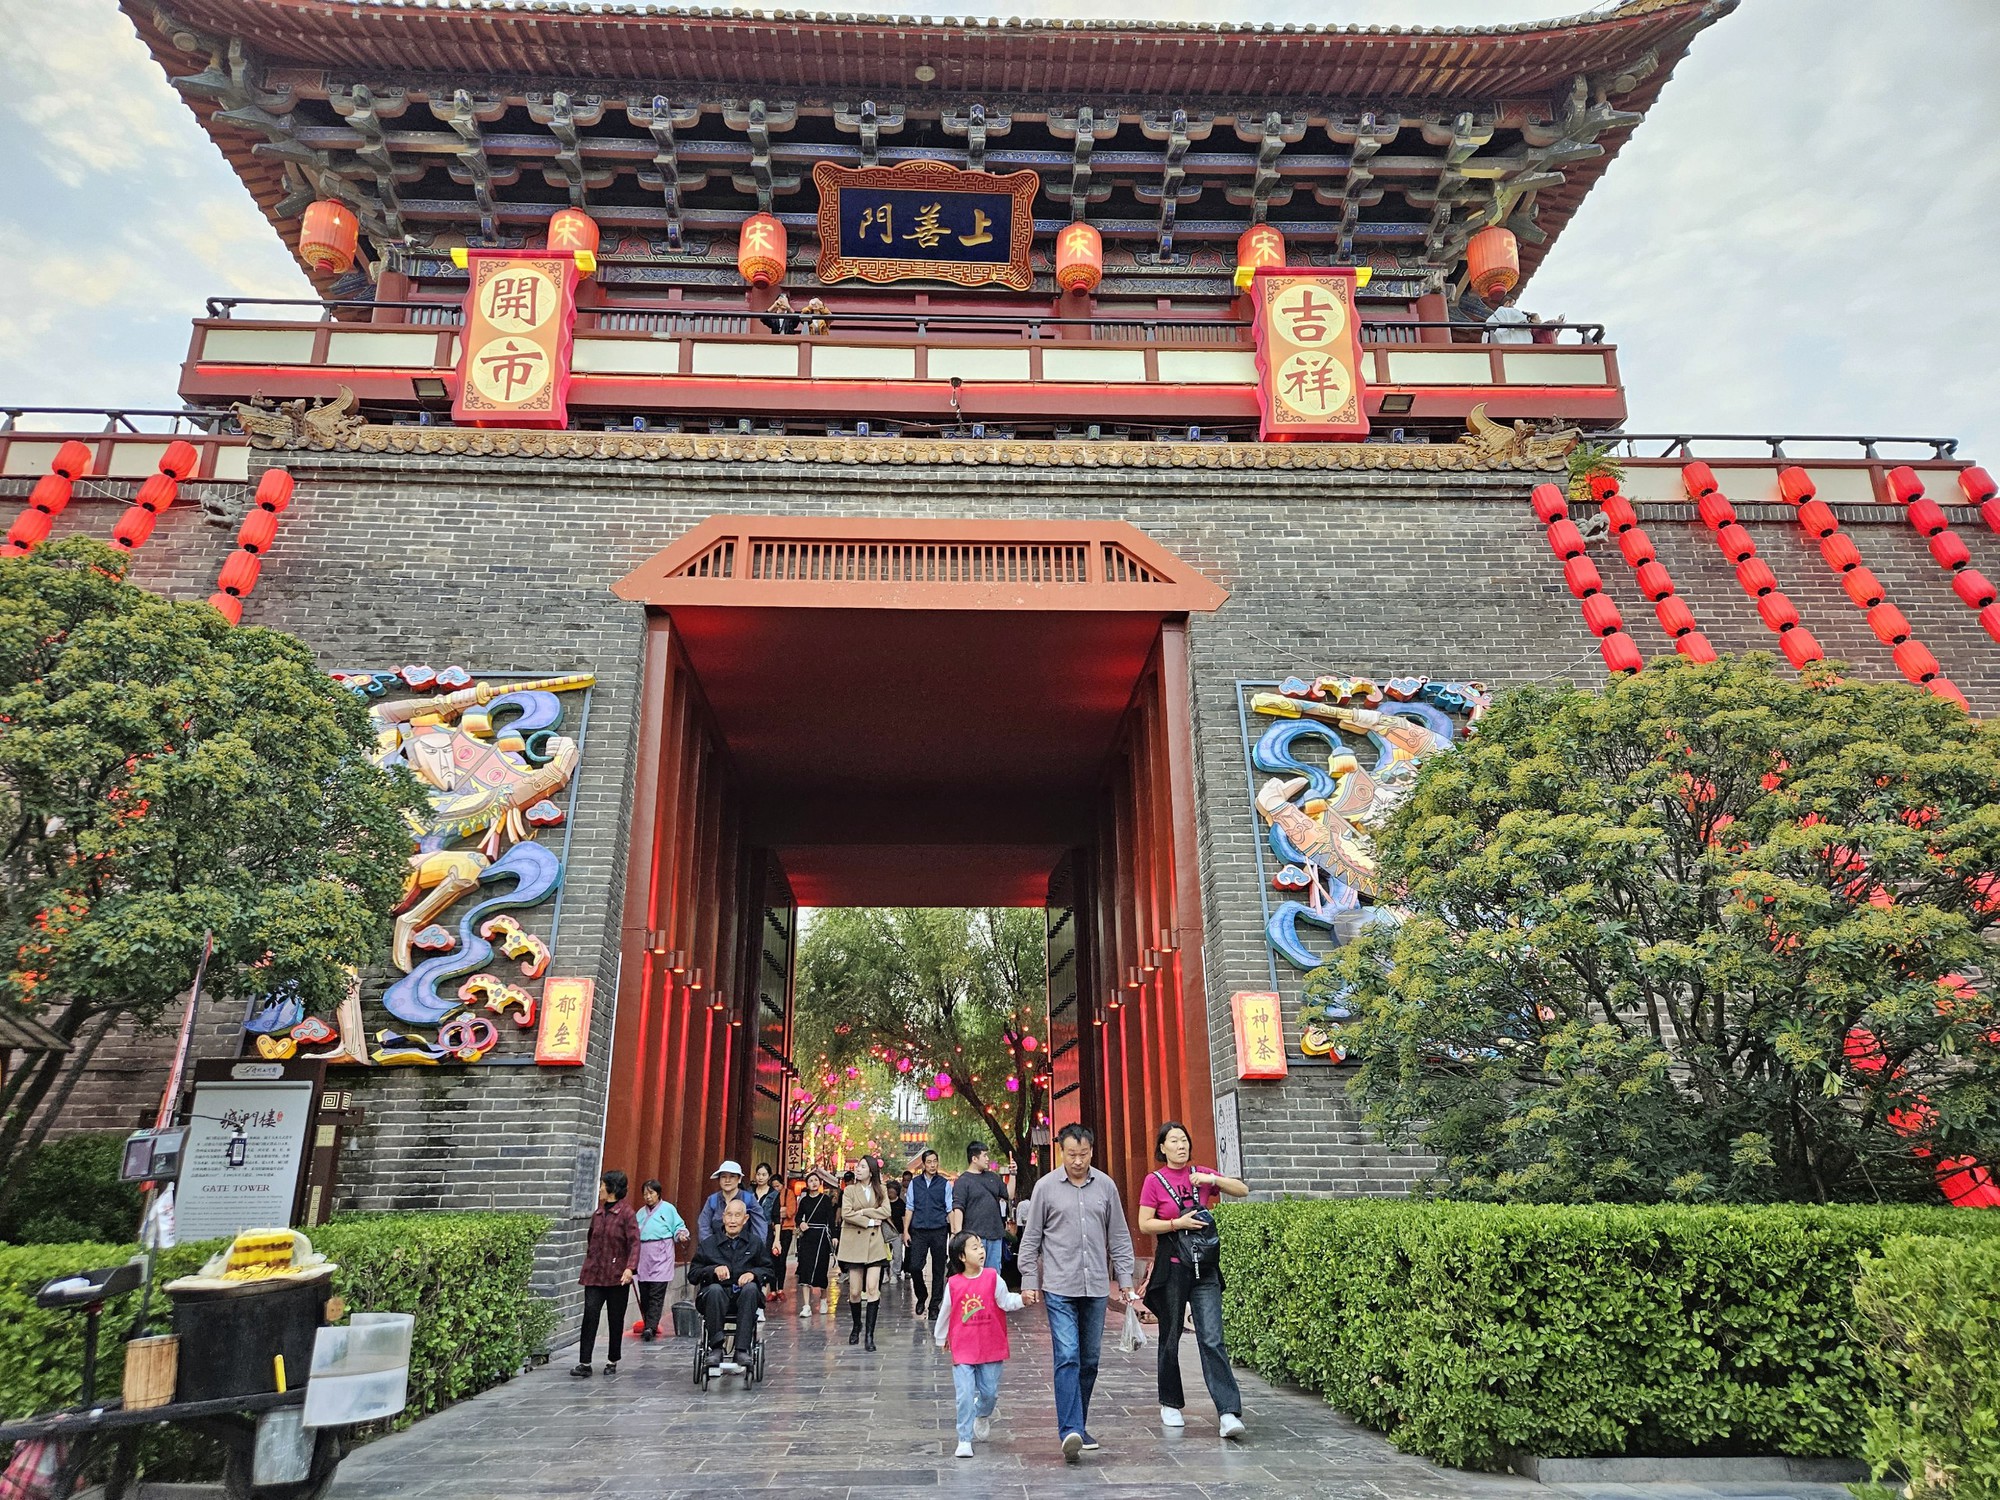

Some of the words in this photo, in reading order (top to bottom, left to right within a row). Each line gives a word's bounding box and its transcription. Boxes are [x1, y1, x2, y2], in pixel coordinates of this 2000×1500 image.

[553, 214, 584, 248] 宋
[745, 221, 774, 252] 宋
[1066, 229, 1093, 258] 宋
[1251, 232, 1281, 263] 宋
[480, 277, 543, 402] 開市
[1281, 291, 1341, 411] 吉祥
[551, 994, 577, 1047] 郁垒
[1252, 1007, 1276, 1061] 神荼
[202, 1184, 230, 1193] GATE
[233, 1184, 270, 1193] TOWER
